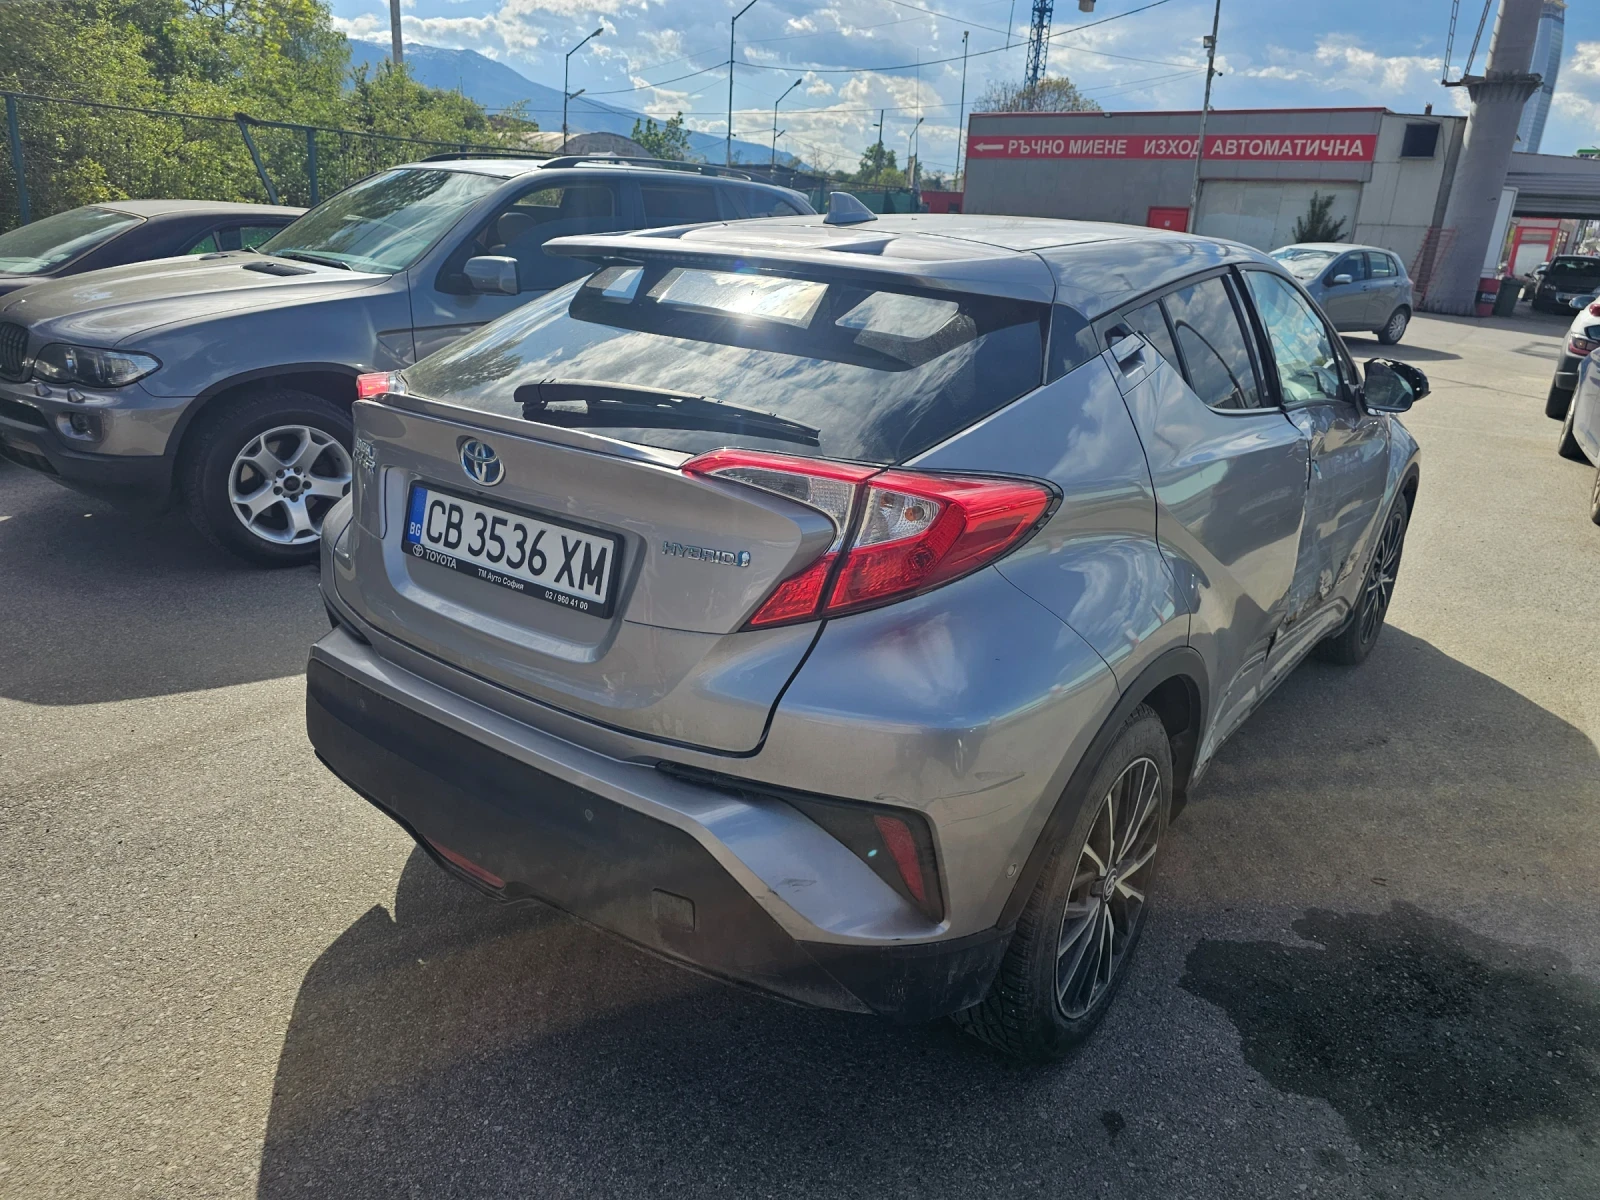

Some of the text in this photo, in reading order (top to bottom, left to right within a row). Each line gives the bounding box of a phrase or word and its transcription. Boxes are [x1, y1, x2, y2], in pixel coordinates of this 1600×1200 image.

[1008, 140, 1064, 155] РЪЧНО
[1069, 139, 1127, 155] МИЕНЕ
[1210, 139, 1364, 157] АВТОМАТИЧНА
[409, 521, 421, 537] BG
[426, 499, 607, 596] CB 3536 XM
[661, 541, 736, 566] HYBRID
[425, 549, 457, 570] TOYOTA
[487, 573, 502, 583] Ауто
[502, 577, 524, 591] София
[544, 590, 553, 600] 02
[557, 594, 569, 605] 960
[570, 598, 578, 608] 41
[579, 601, 589, 611] 00
